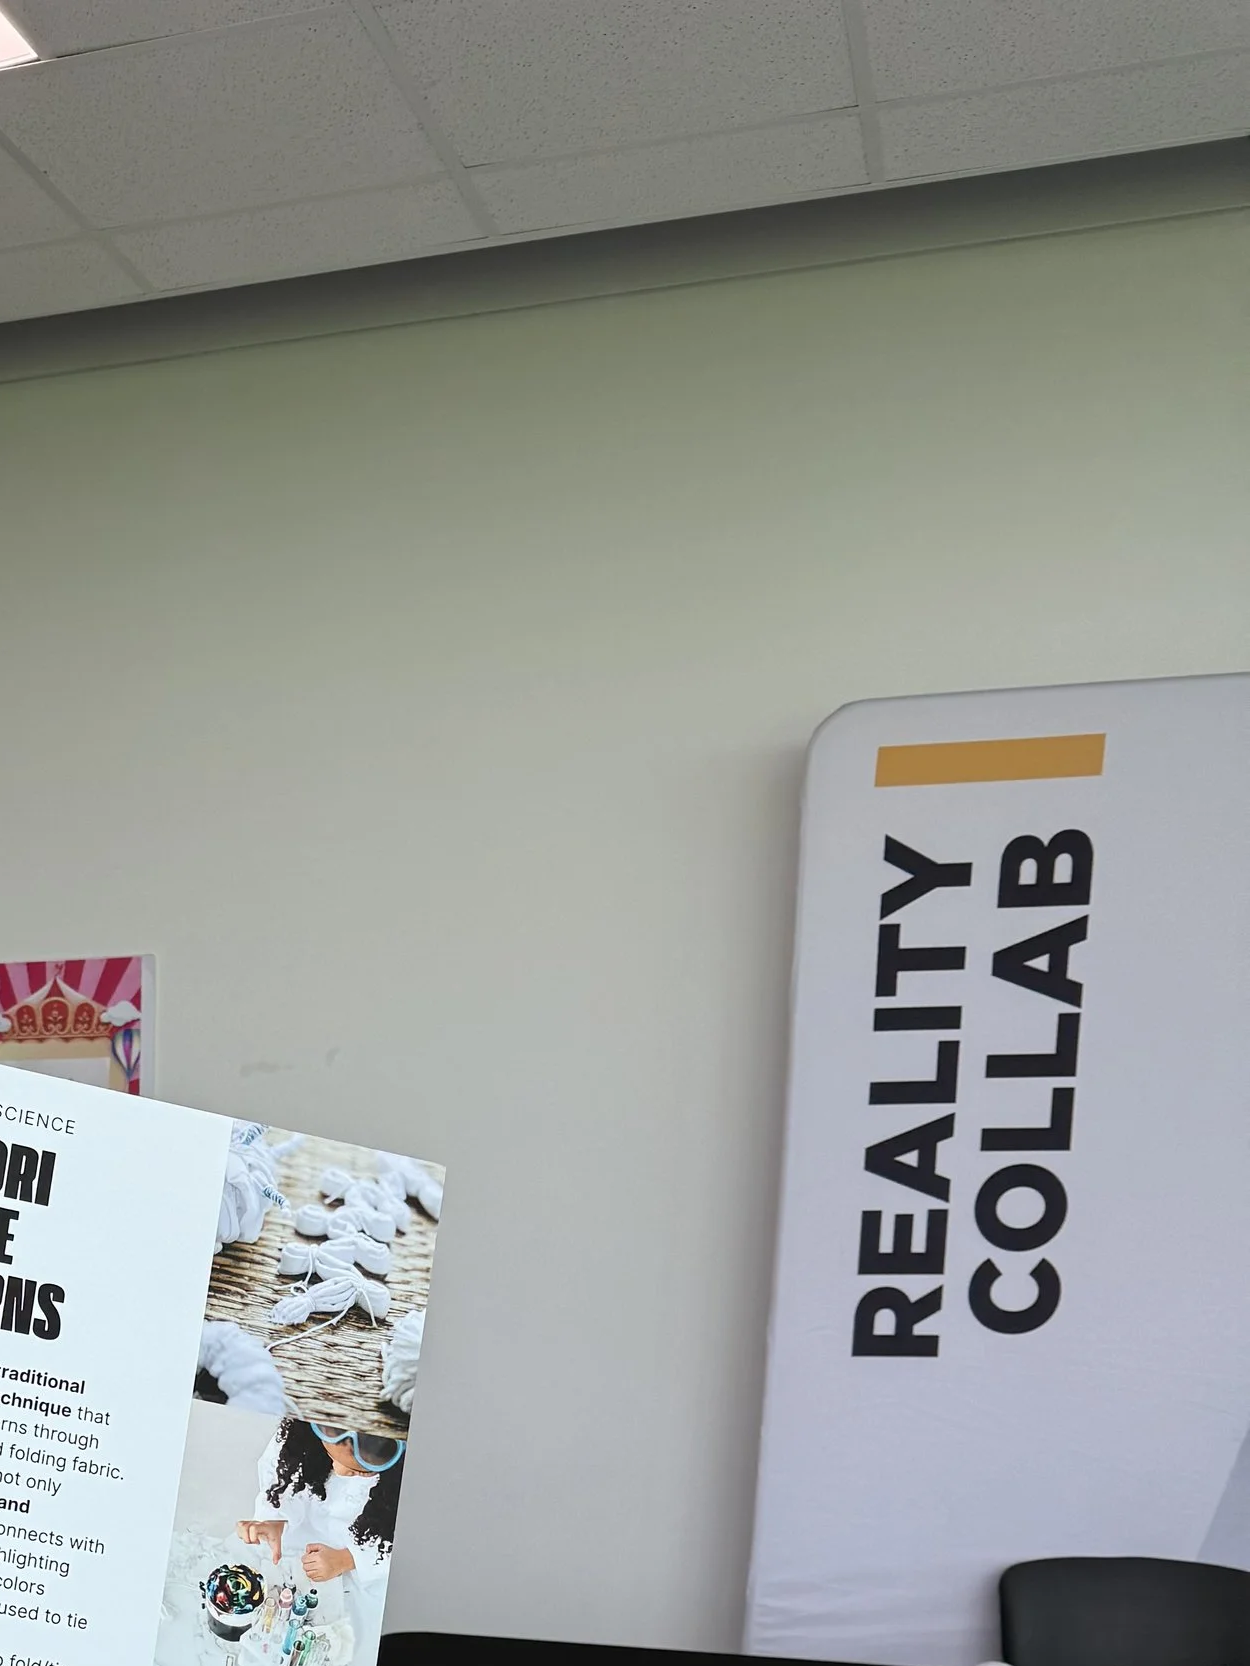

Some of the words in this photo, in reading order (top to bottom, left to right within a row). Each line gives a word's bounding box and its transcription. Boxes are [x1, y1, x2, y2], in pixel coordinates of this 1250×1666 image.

[968, 828, 1095, 1335] COLLAB
[851, 834, 973, 1357] REALITY
[77, 1406, 111, 1426] that
[33, 1423, 99, 1451] through
[9, 1443, 67, 1473] folding
[72, 1455, 124, 1481] fabric.
[25, 1476, 62, 1497] only
[69, 1536, 105, 1555] with
[44, 1608, 62, 1625] to
[67, 1612, 88, 1630] tie
